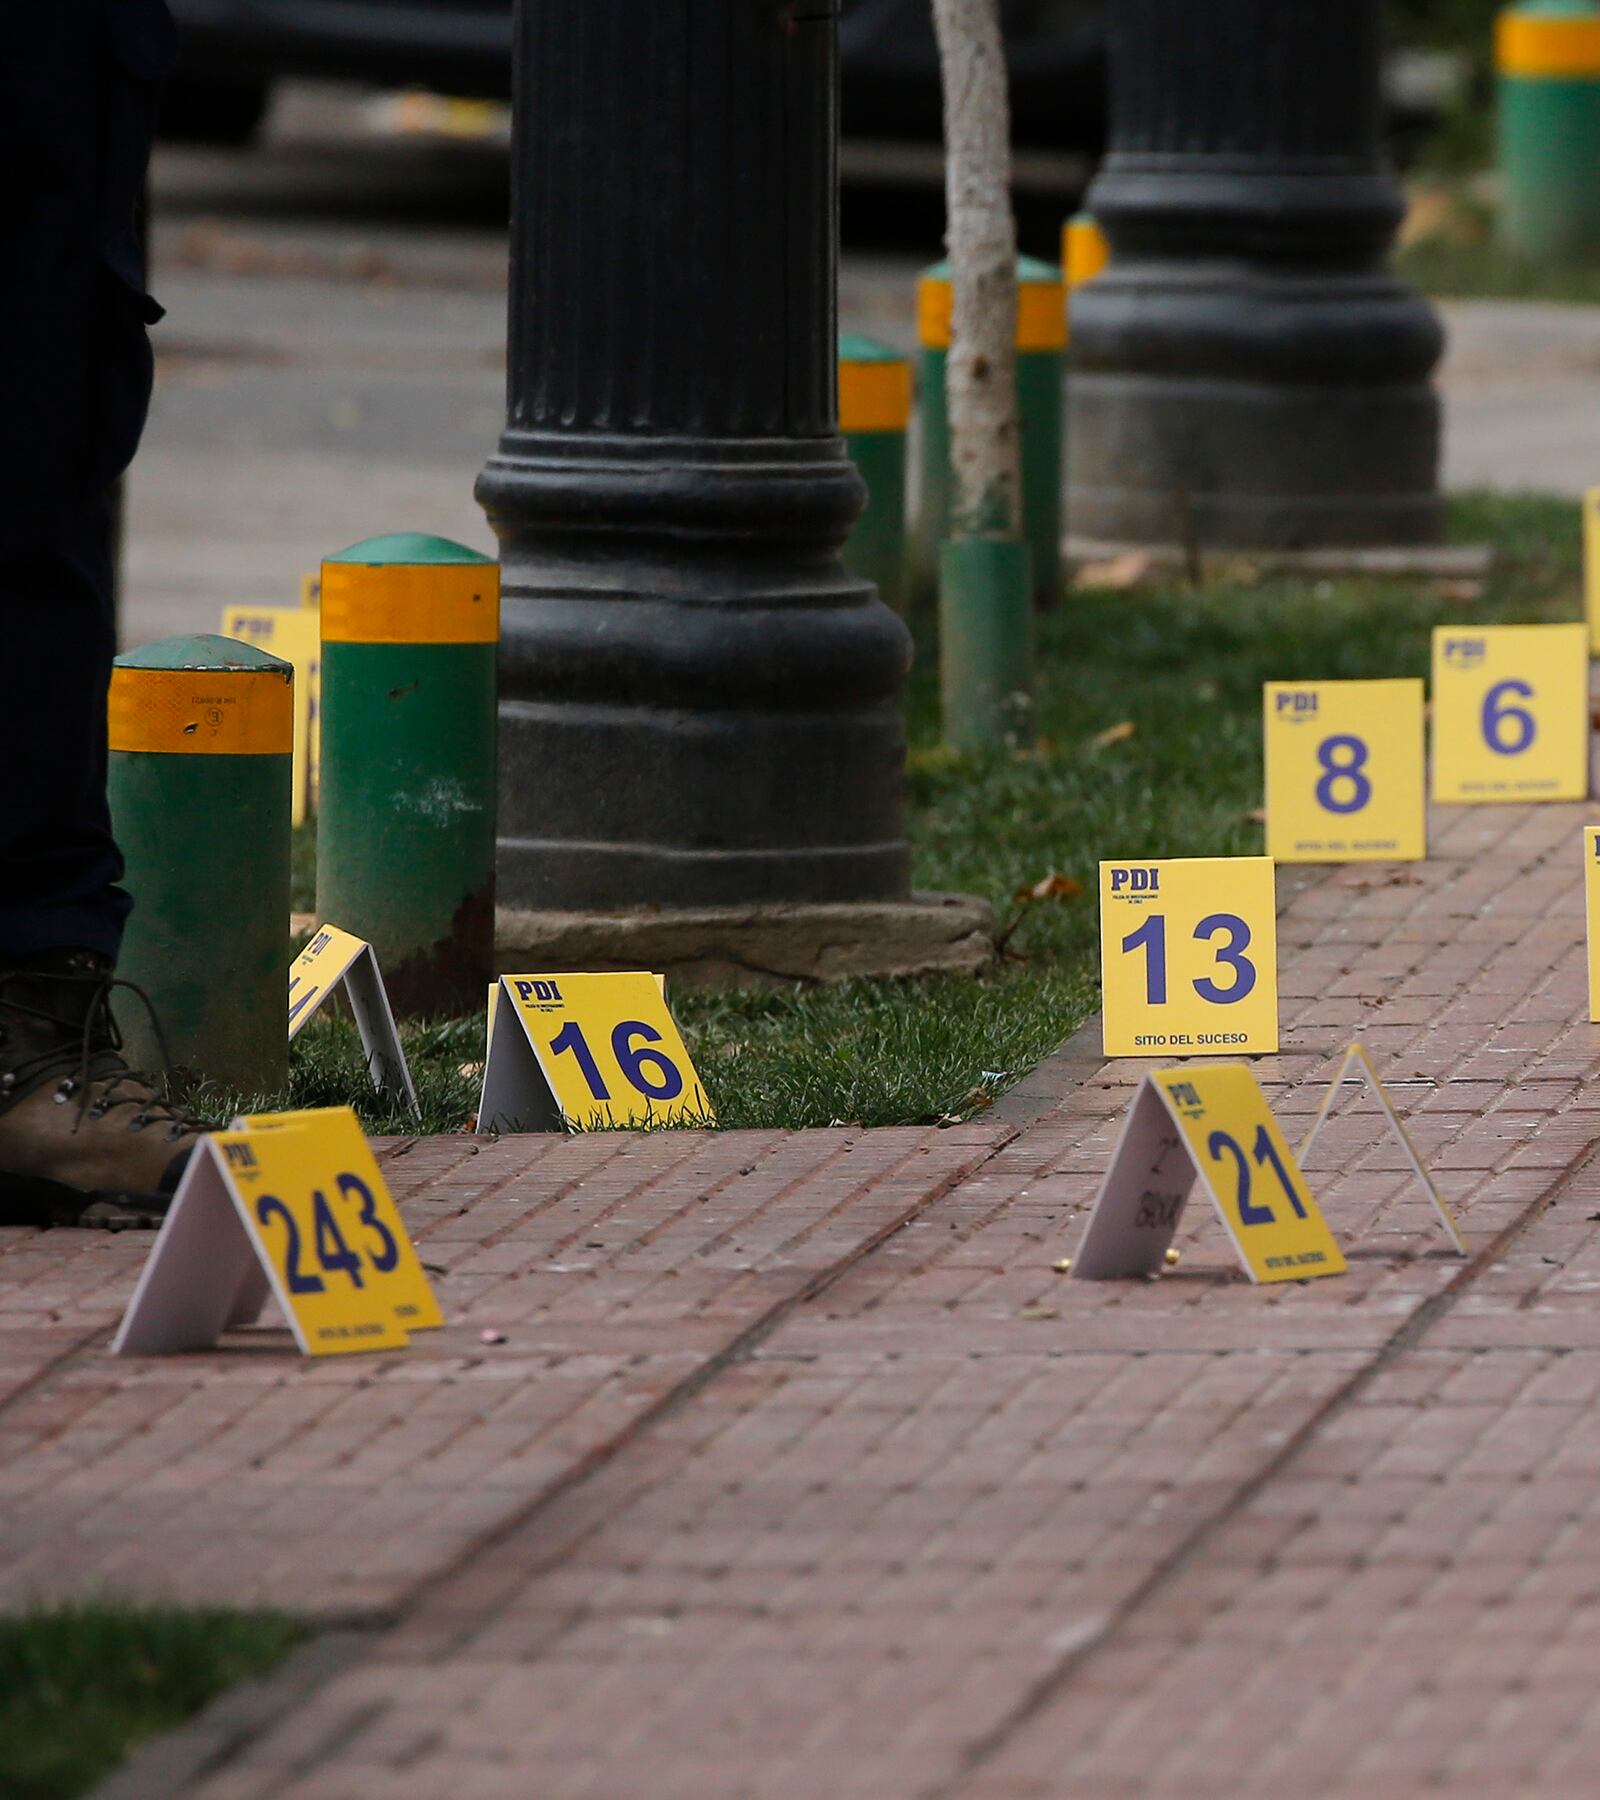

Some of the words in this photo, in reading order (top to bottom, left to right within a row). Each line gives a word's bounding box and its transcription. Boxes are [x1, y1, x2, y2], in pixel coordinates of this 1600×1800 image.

[1276, 692, 1318, 711] PDI
[1480, 679, 1537, 756] 6
[1315, 733, 1372, 815] 8
[1111, 868, 1159, 891] PDI
[514, 980, 563, 1001] PDI
[1122, 913, 1257, 1005] 13
[549, 1020, 683, 1101] 16
[1134, 1035, 1166, 1046] SITIO
[1169, 1034, 1194, 1045] DEL
[1197, 1032, 1248, 1044] SUCESO
[1208, 1124, 1308, 1226] 21
